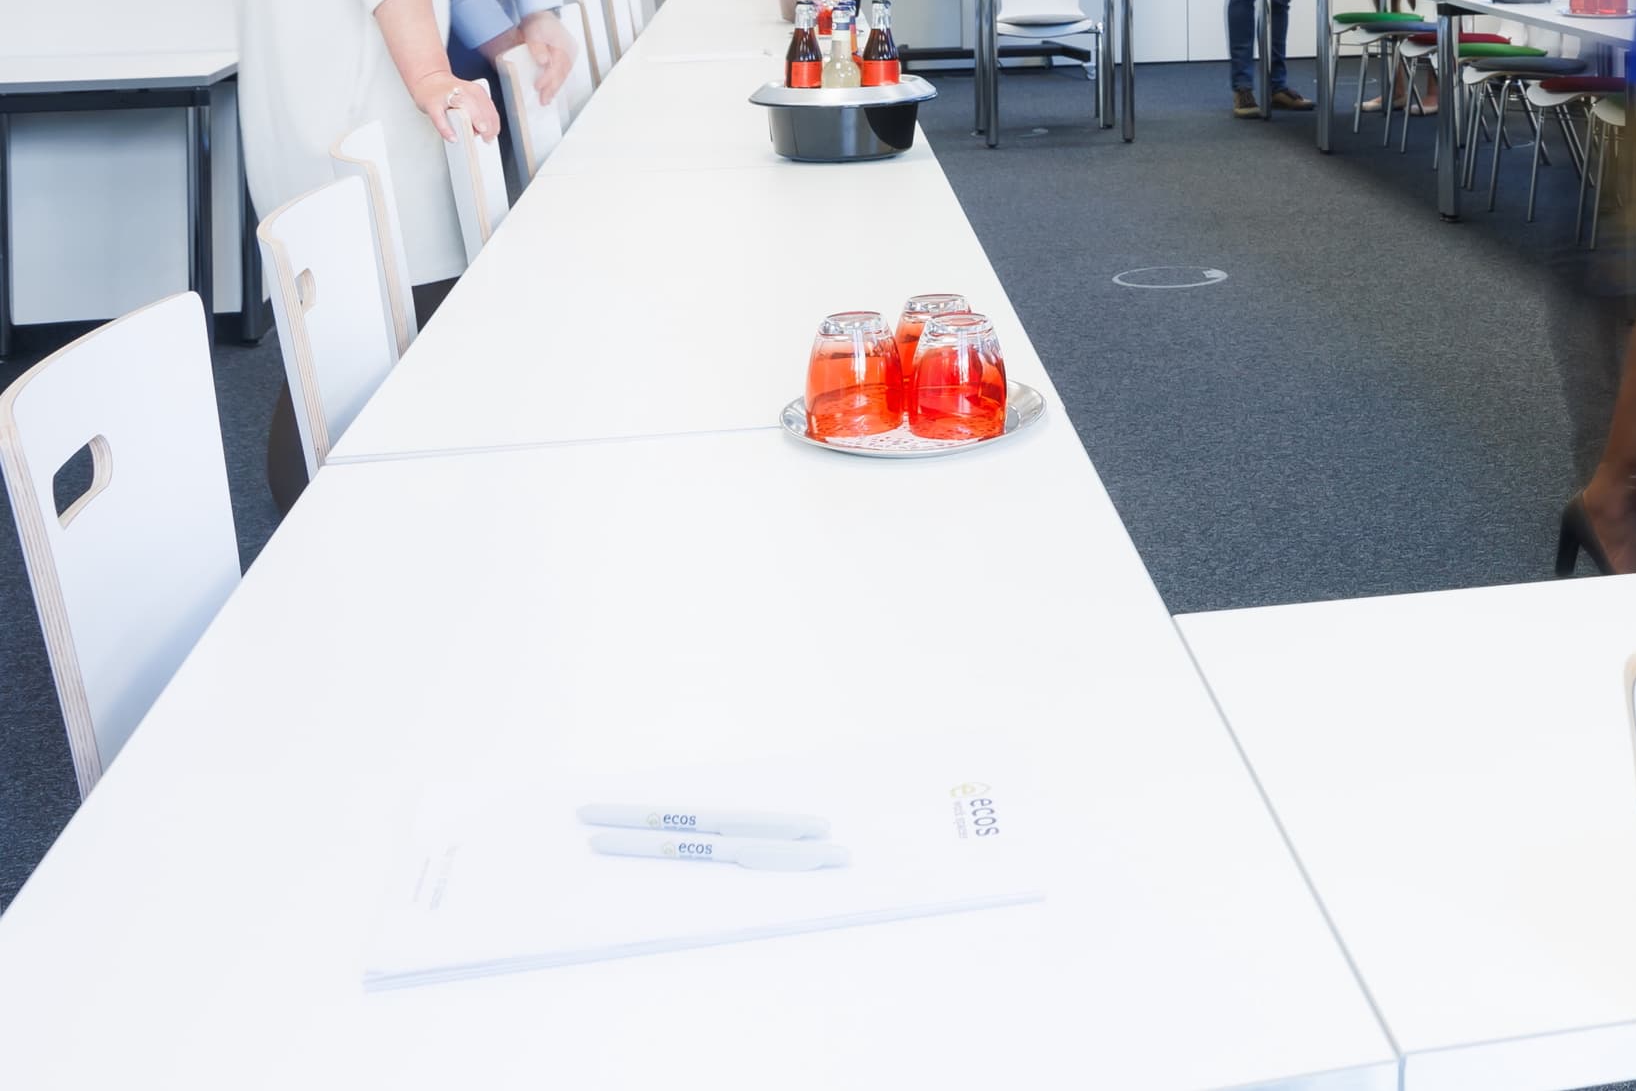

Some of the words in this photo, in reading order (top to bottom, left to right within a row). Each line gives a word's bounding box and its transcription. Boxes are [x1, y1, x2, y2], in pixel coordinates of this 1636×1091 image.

[663, 813, 697, 826] ecos
[969, 797, 1000, 838] ecos
[678, 842, 713, 855] ecos
